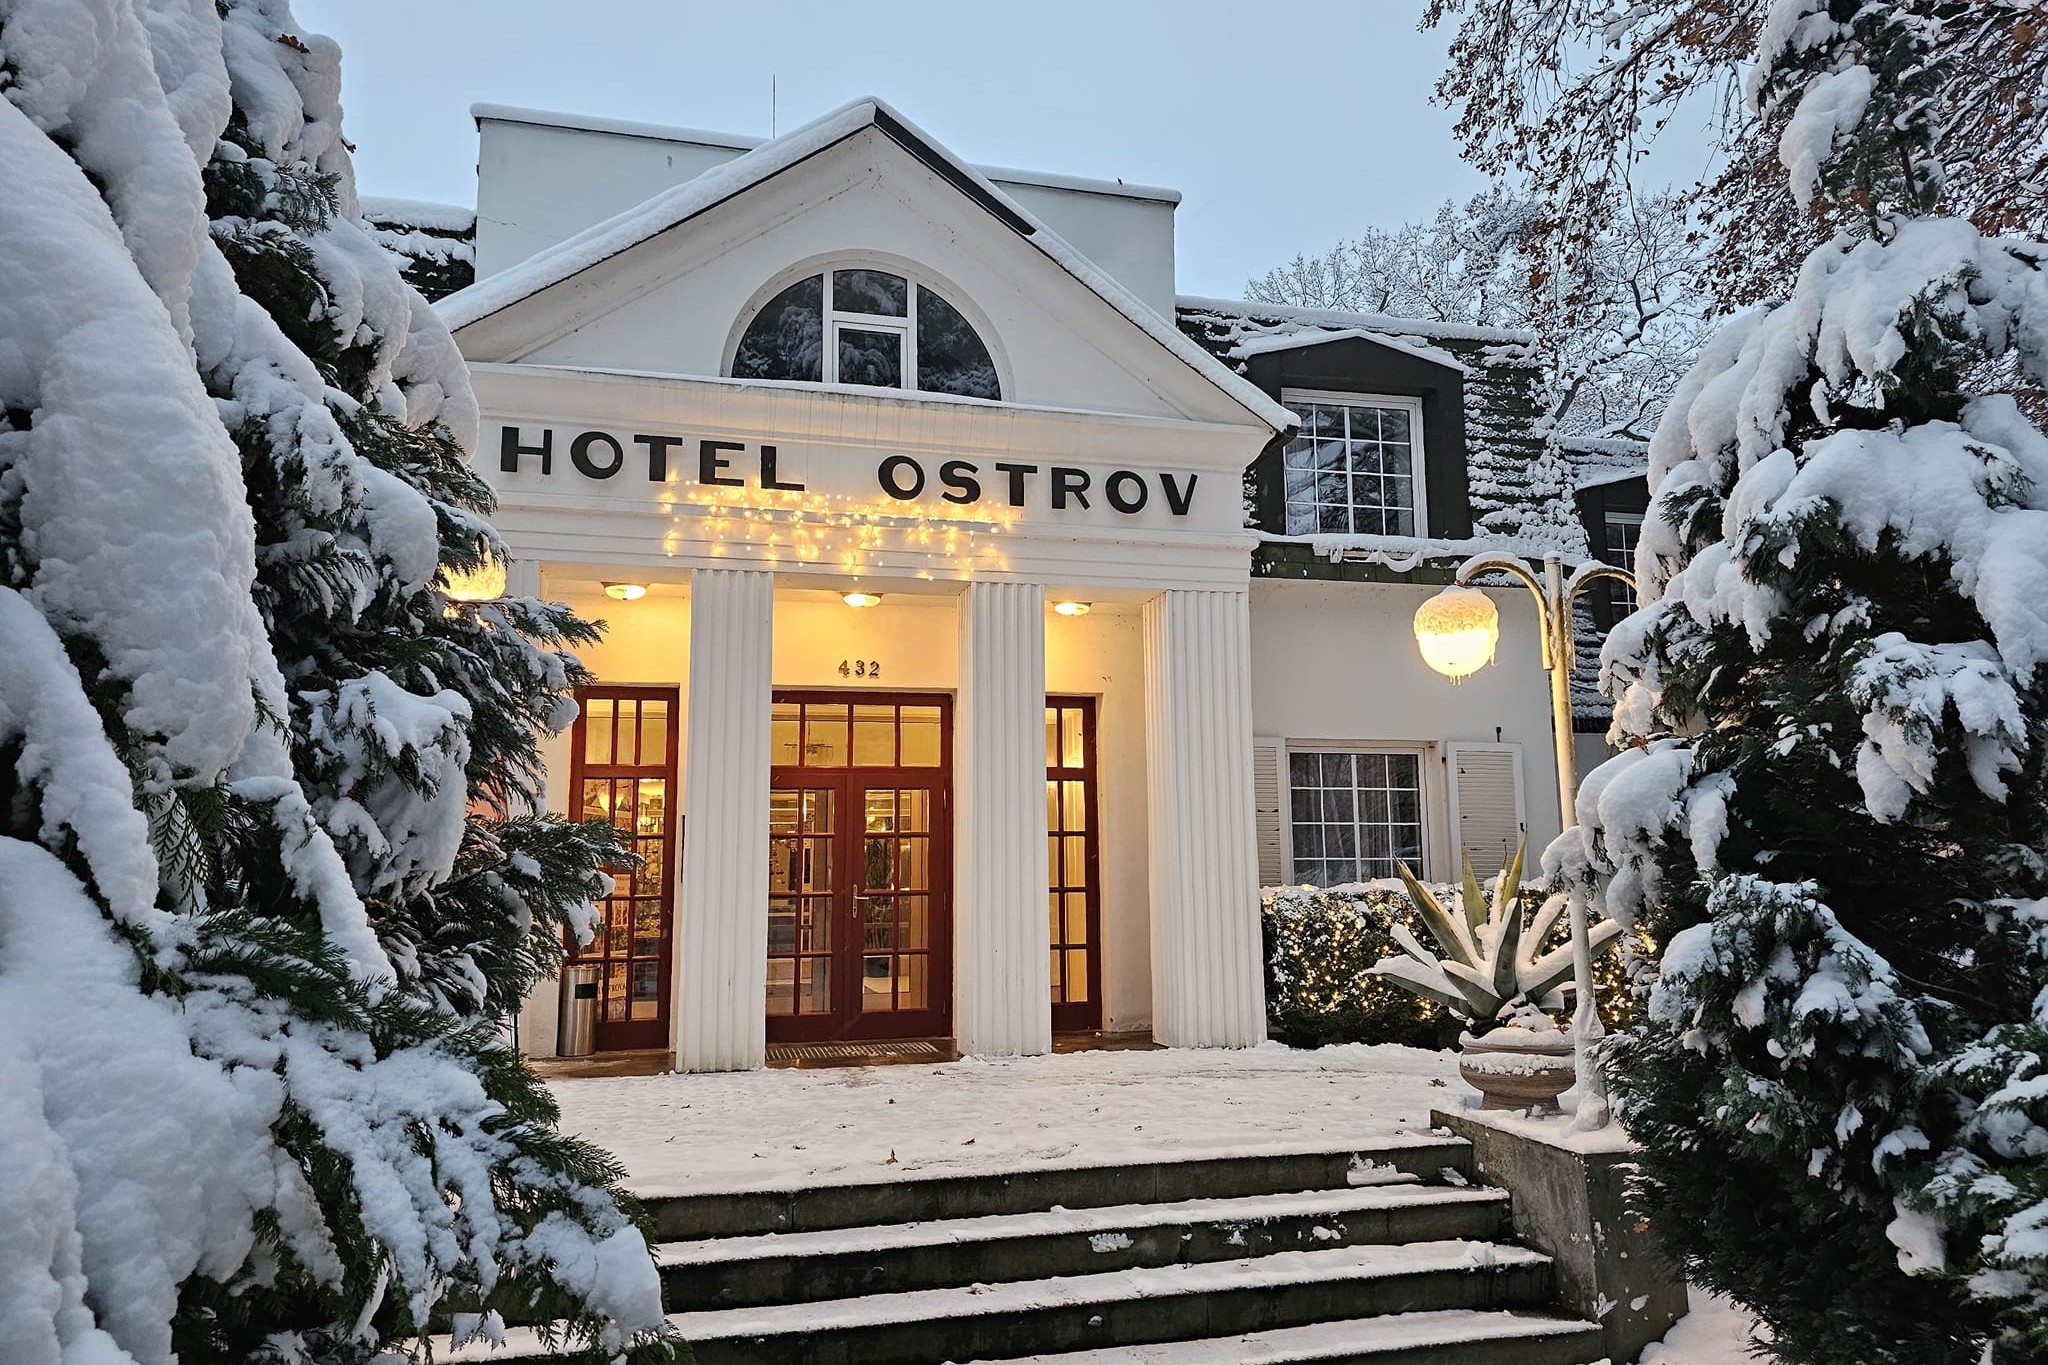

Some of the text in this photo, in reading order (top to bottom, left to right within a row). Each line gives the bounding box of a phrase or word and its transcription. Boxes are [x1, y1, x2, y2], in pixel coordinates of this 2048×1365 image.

[500, 426, 1198, 516] HOTEL OSTROV
[838, 659, 880, 678] 432
